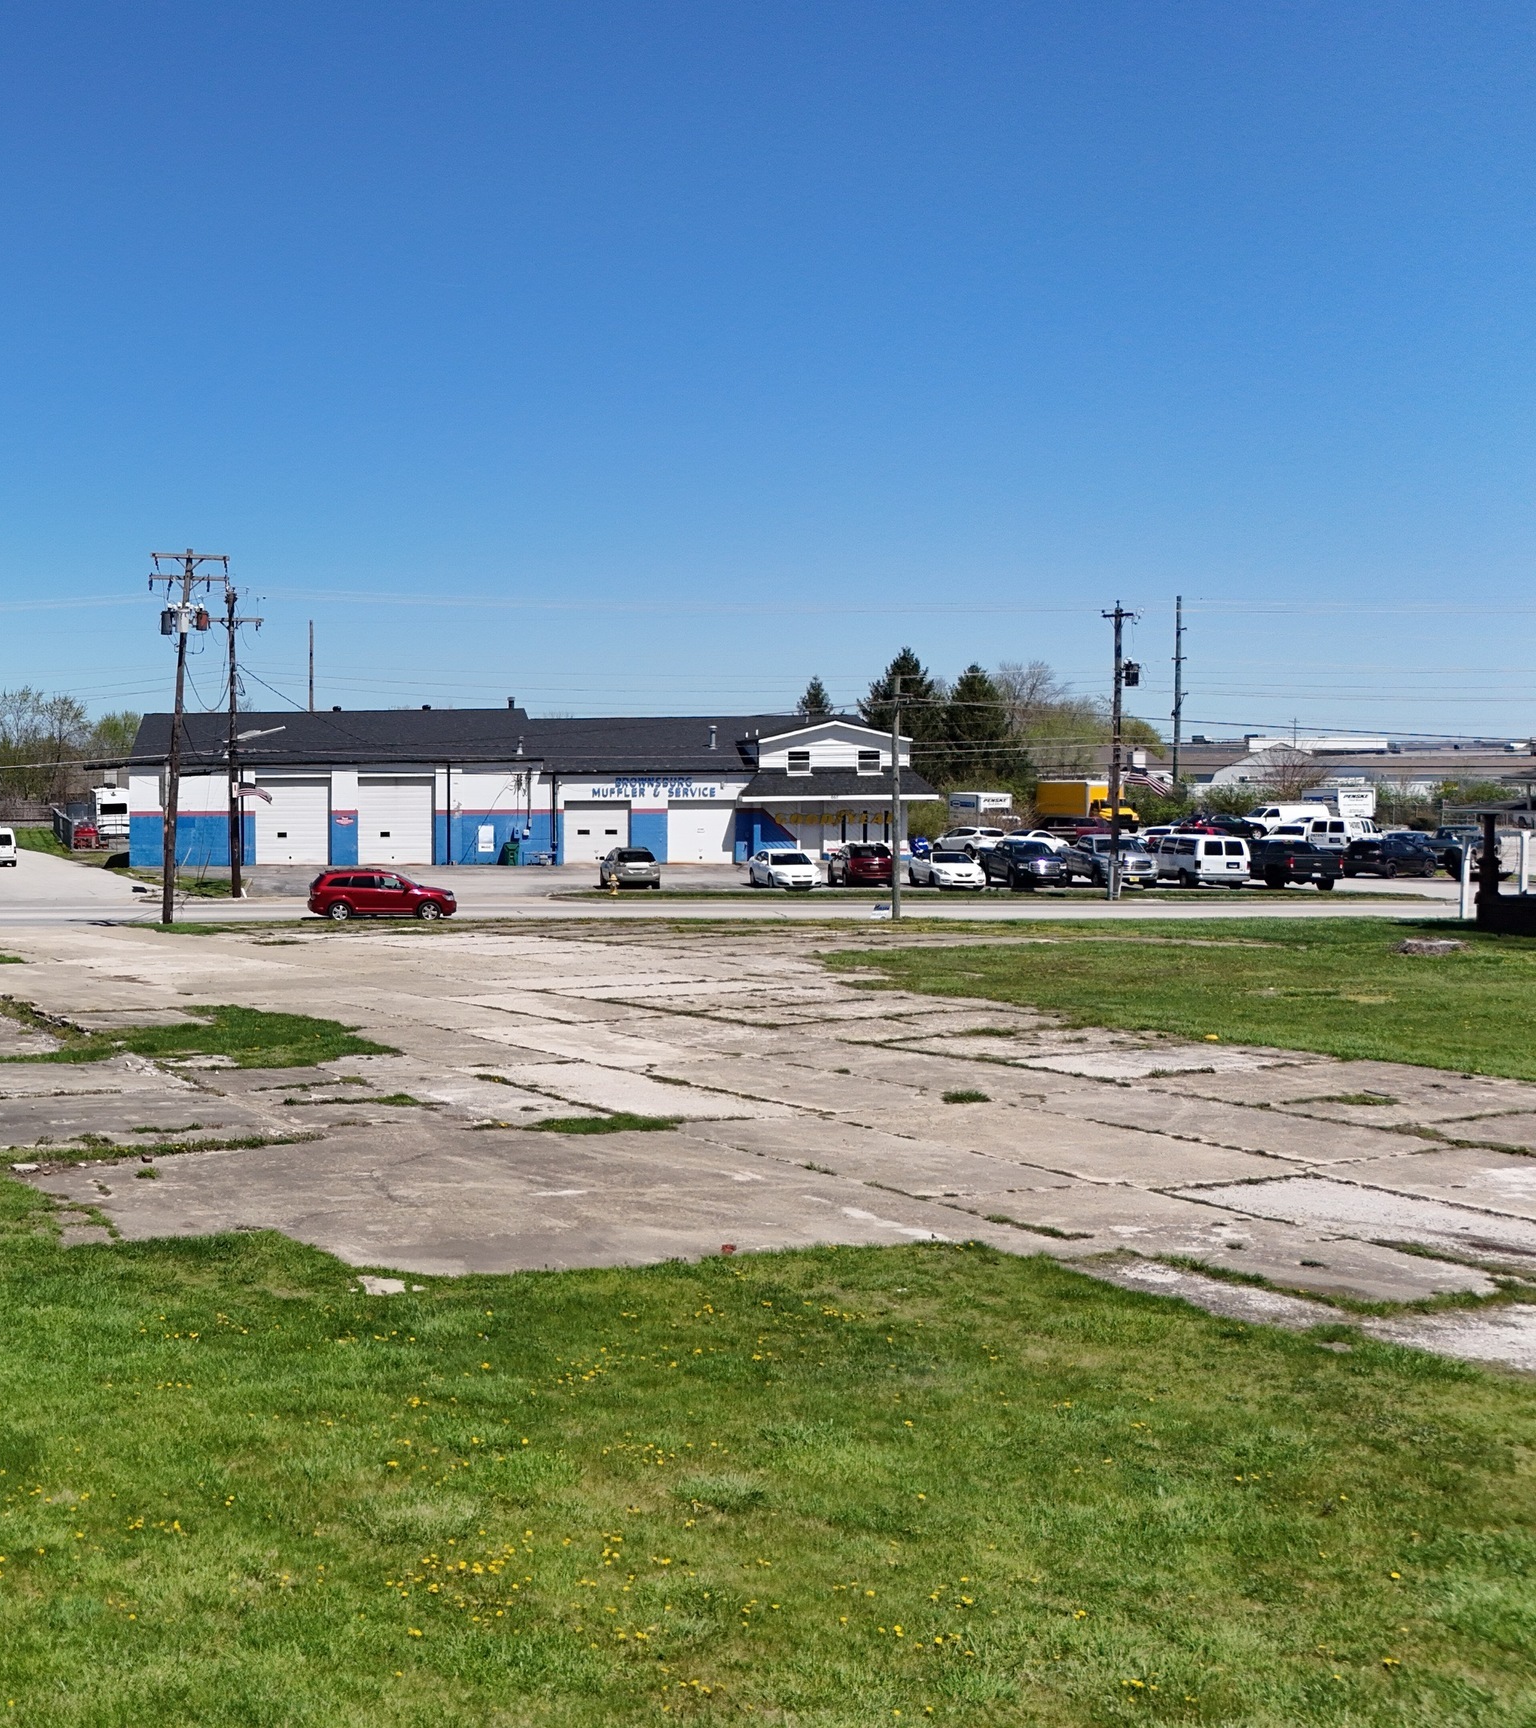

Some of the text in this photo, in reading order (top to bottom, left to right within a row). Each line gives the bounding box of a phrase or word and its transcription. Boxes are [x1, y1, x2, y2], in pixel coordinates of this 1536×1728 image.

[615, 777, 692, 788] BROWNSBURG
[591, 788, 645, 798] MUFFLER
[667, 787, 716, 798] SERVICE
